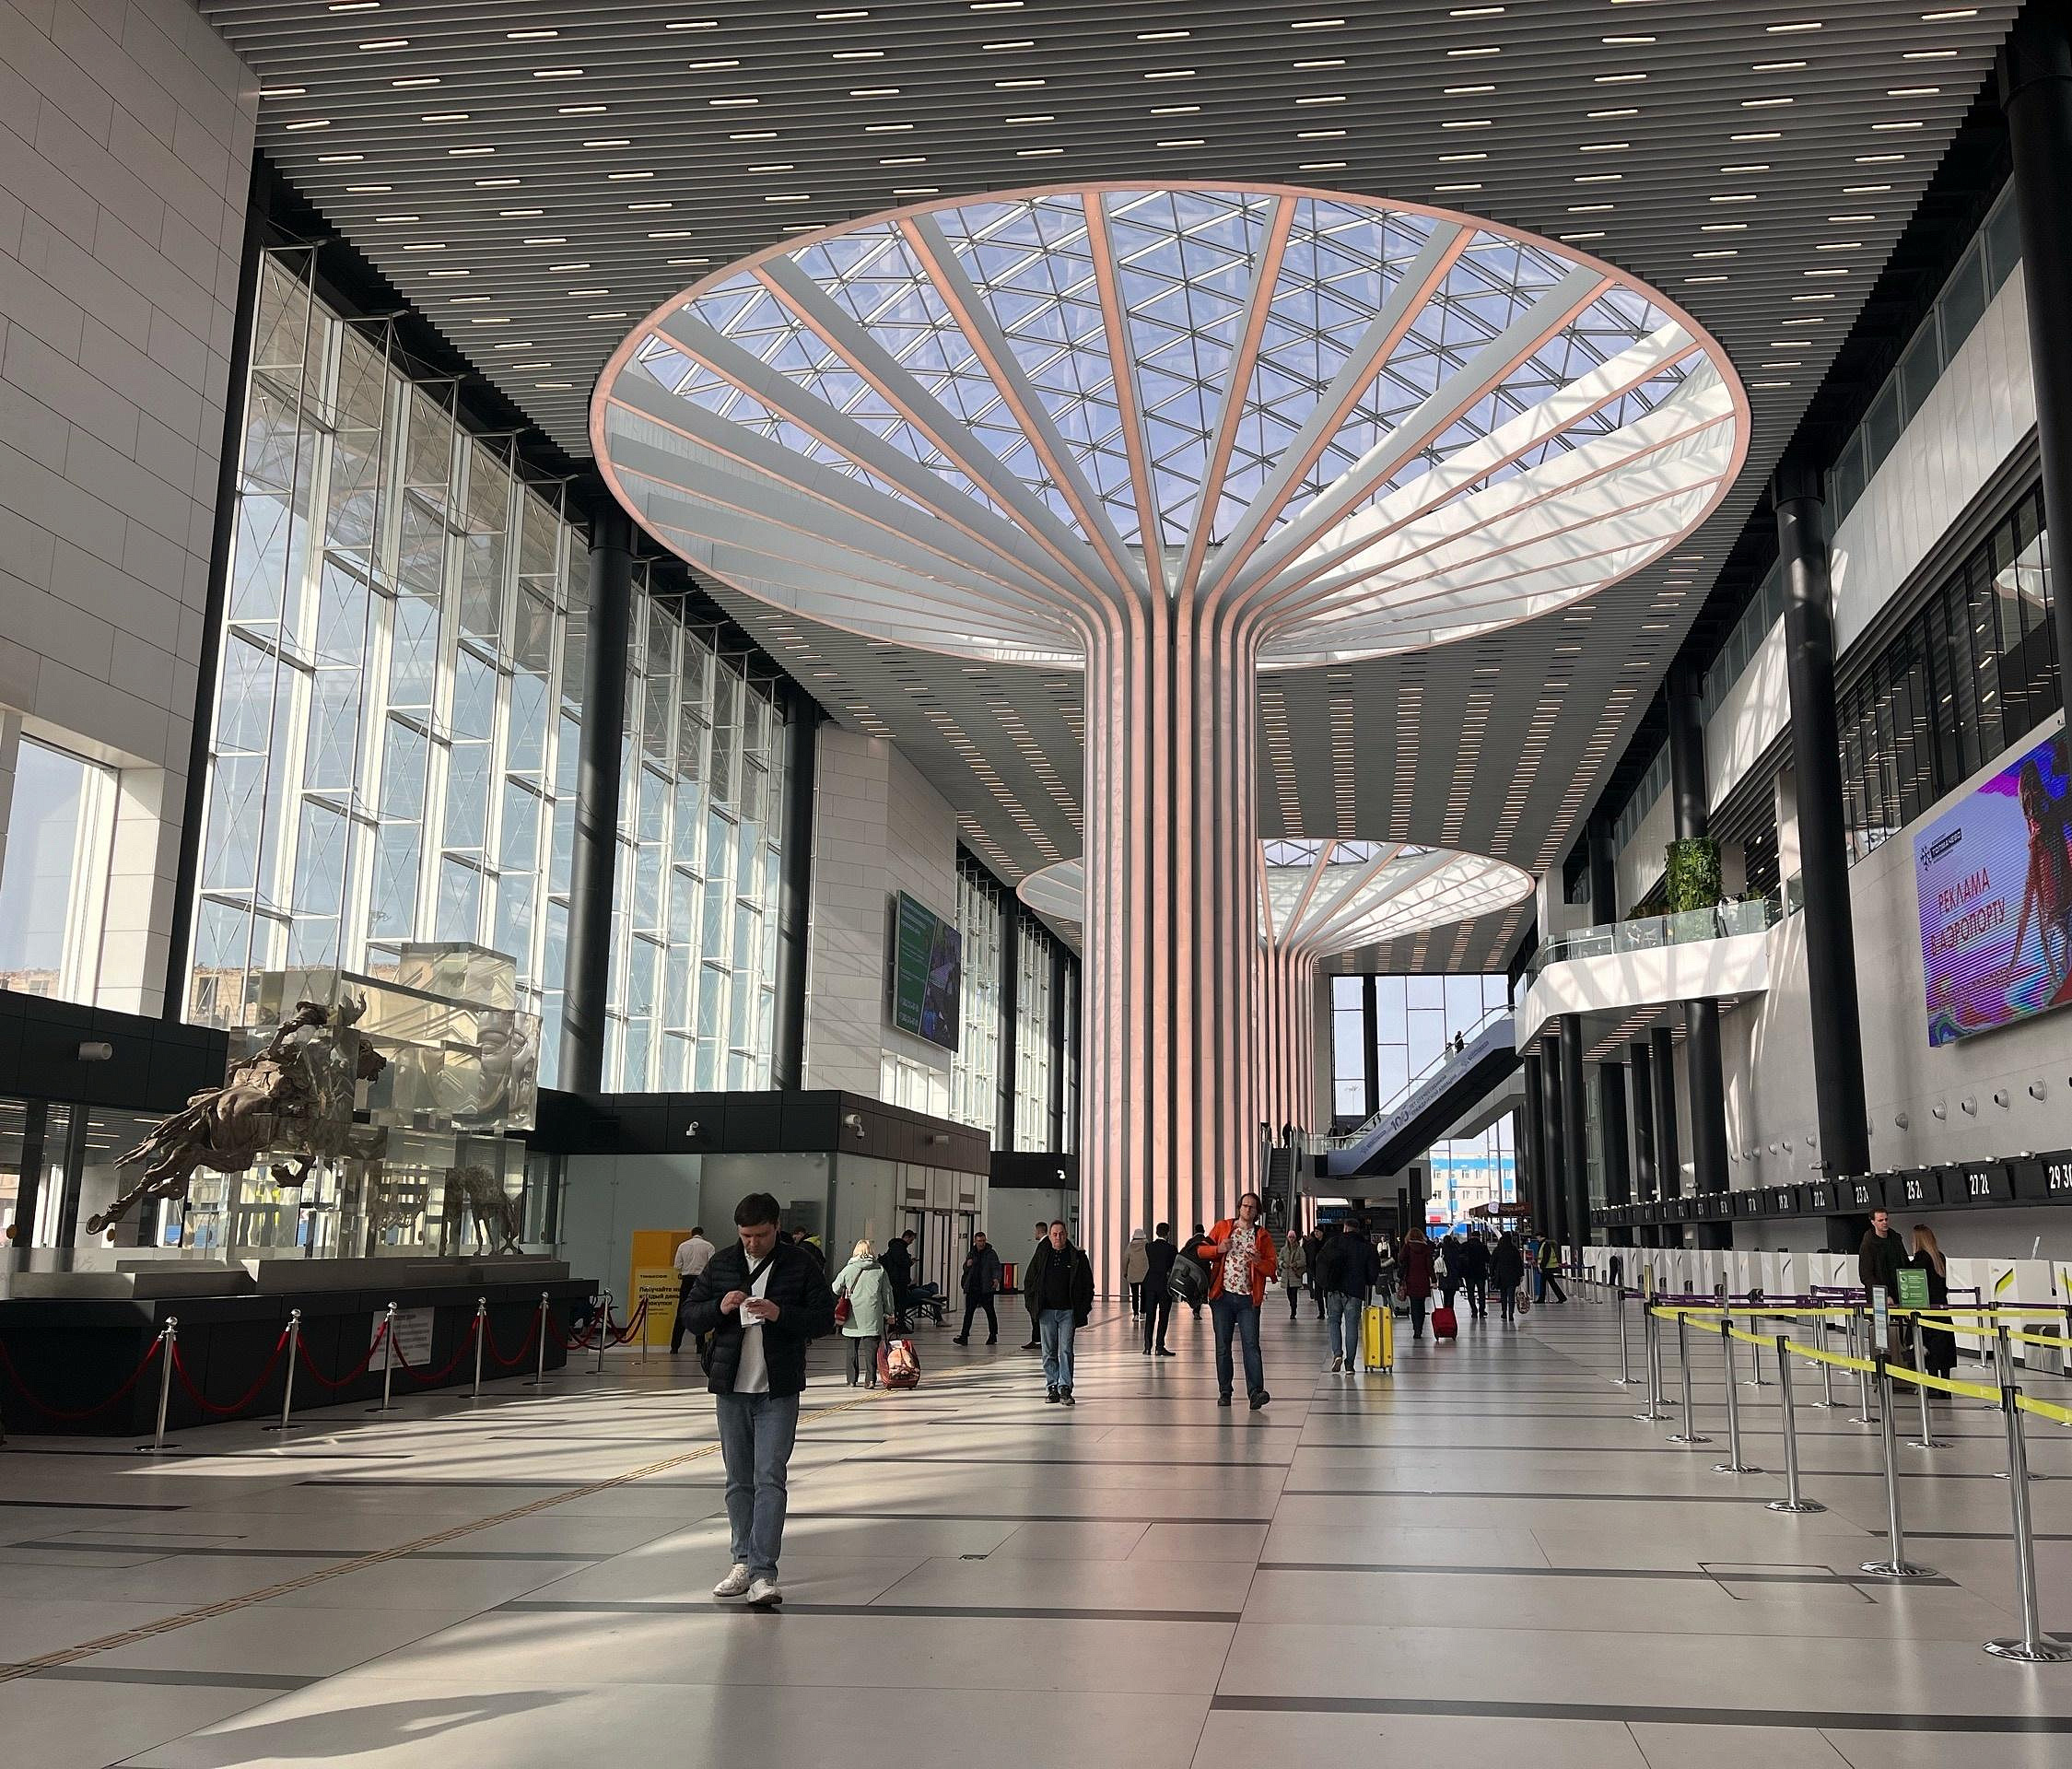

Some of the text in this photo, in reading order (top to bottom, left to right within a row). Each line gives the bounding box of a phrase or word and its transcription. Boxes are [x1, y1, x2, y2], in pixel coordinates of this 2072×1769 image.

[1937, 867, 1991, 917] РЕКЛАМА
[1940, 897, 2006, 953] АЭРОПОРТУ
[1969, 1174, 1979, 1195] 27
[2048, 1165, 2061, 1189] 29
[1906, 1179, 1915, 1200] 25
